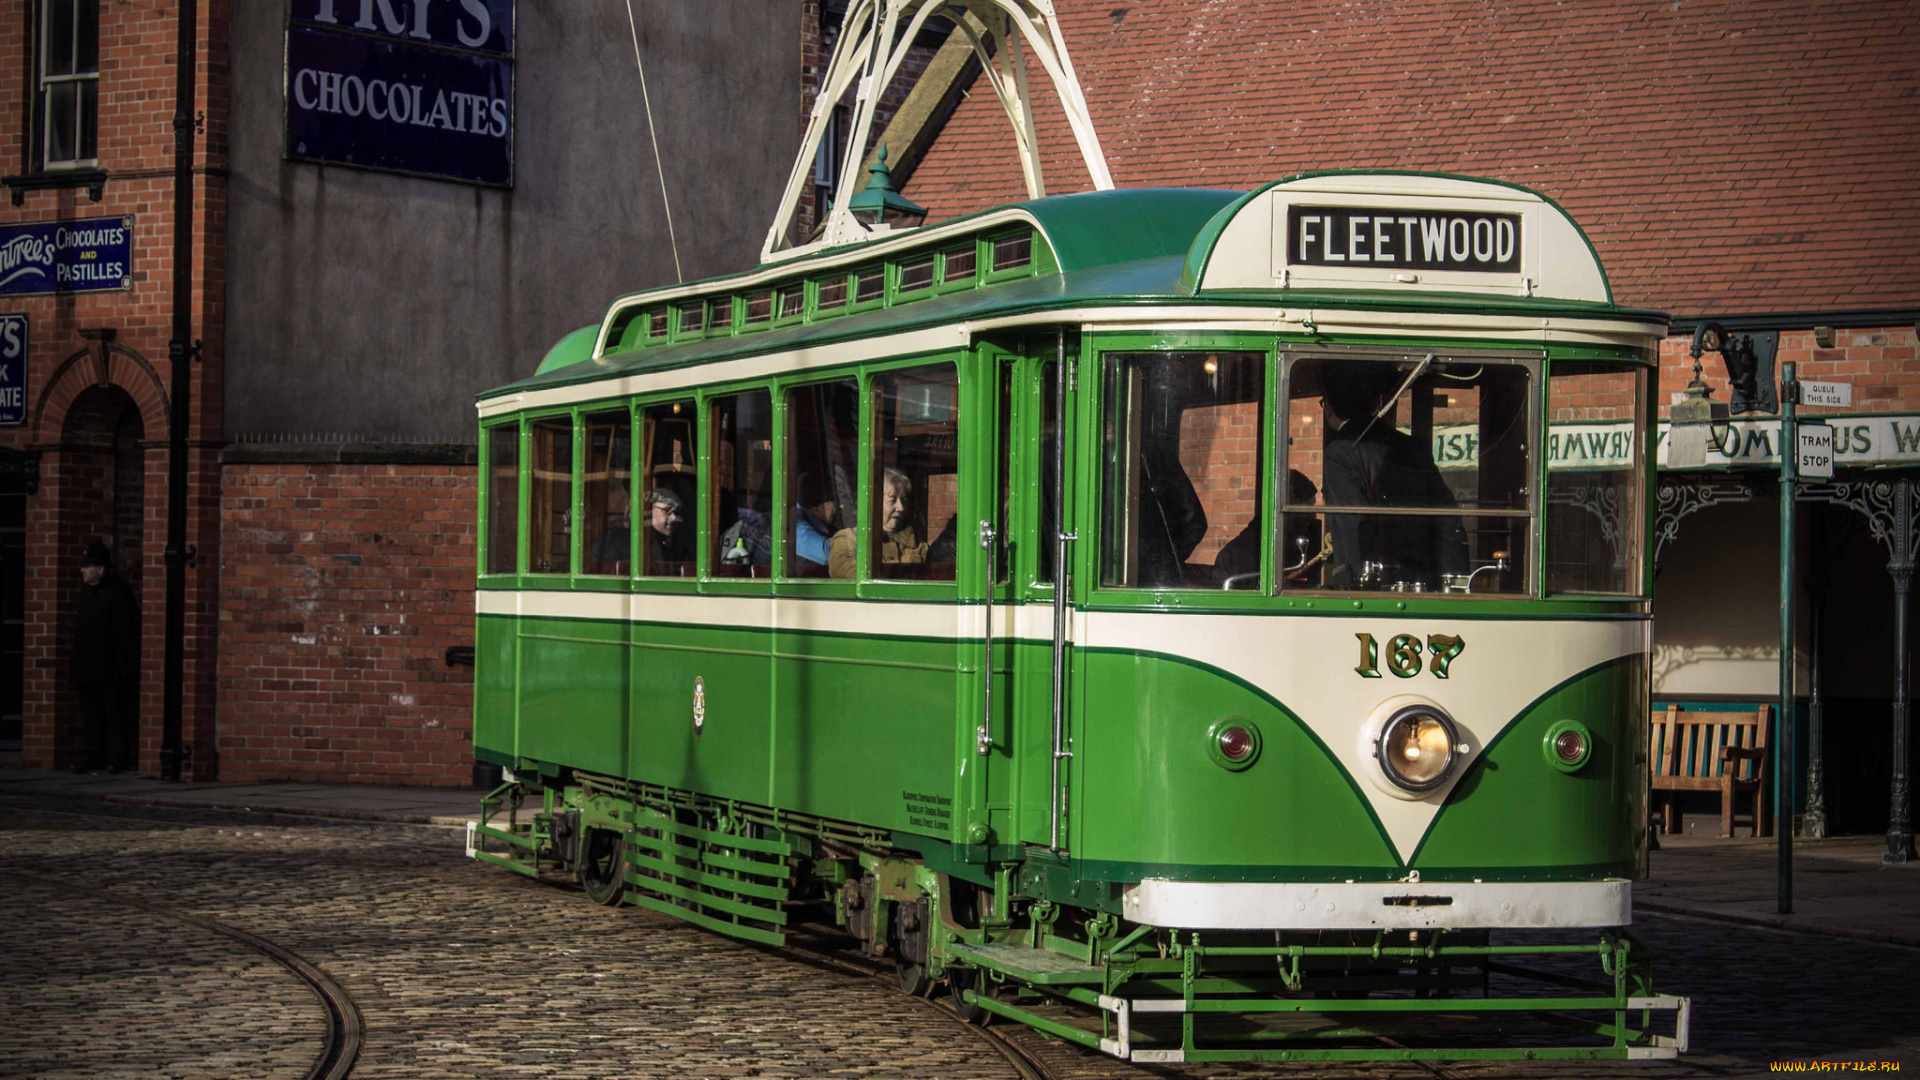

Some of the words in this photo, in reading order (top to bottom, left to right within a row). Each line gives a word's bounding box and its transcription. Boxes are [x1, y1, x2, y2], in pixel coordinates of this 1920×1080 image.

[294, 68, 508, 138] CHOCOLATES
[56, 227, 125, 250] CHOCOLATES
[1300, 216, 1515, 263] FLEETWOOD
[80, 250, 98, 260] AND
[57, 262, 123, 281] PASTILLES
[1812, 385, 1836, 394] QUEUE
[1807, 394, 1823, 403] THIS
[1826, 396, 1842, 404] SIDE
[1801, 435, 1831, 447] TRAM
[1803, 455, 1829, 467] STOP
[1354, 633, 1466, 679] 167
